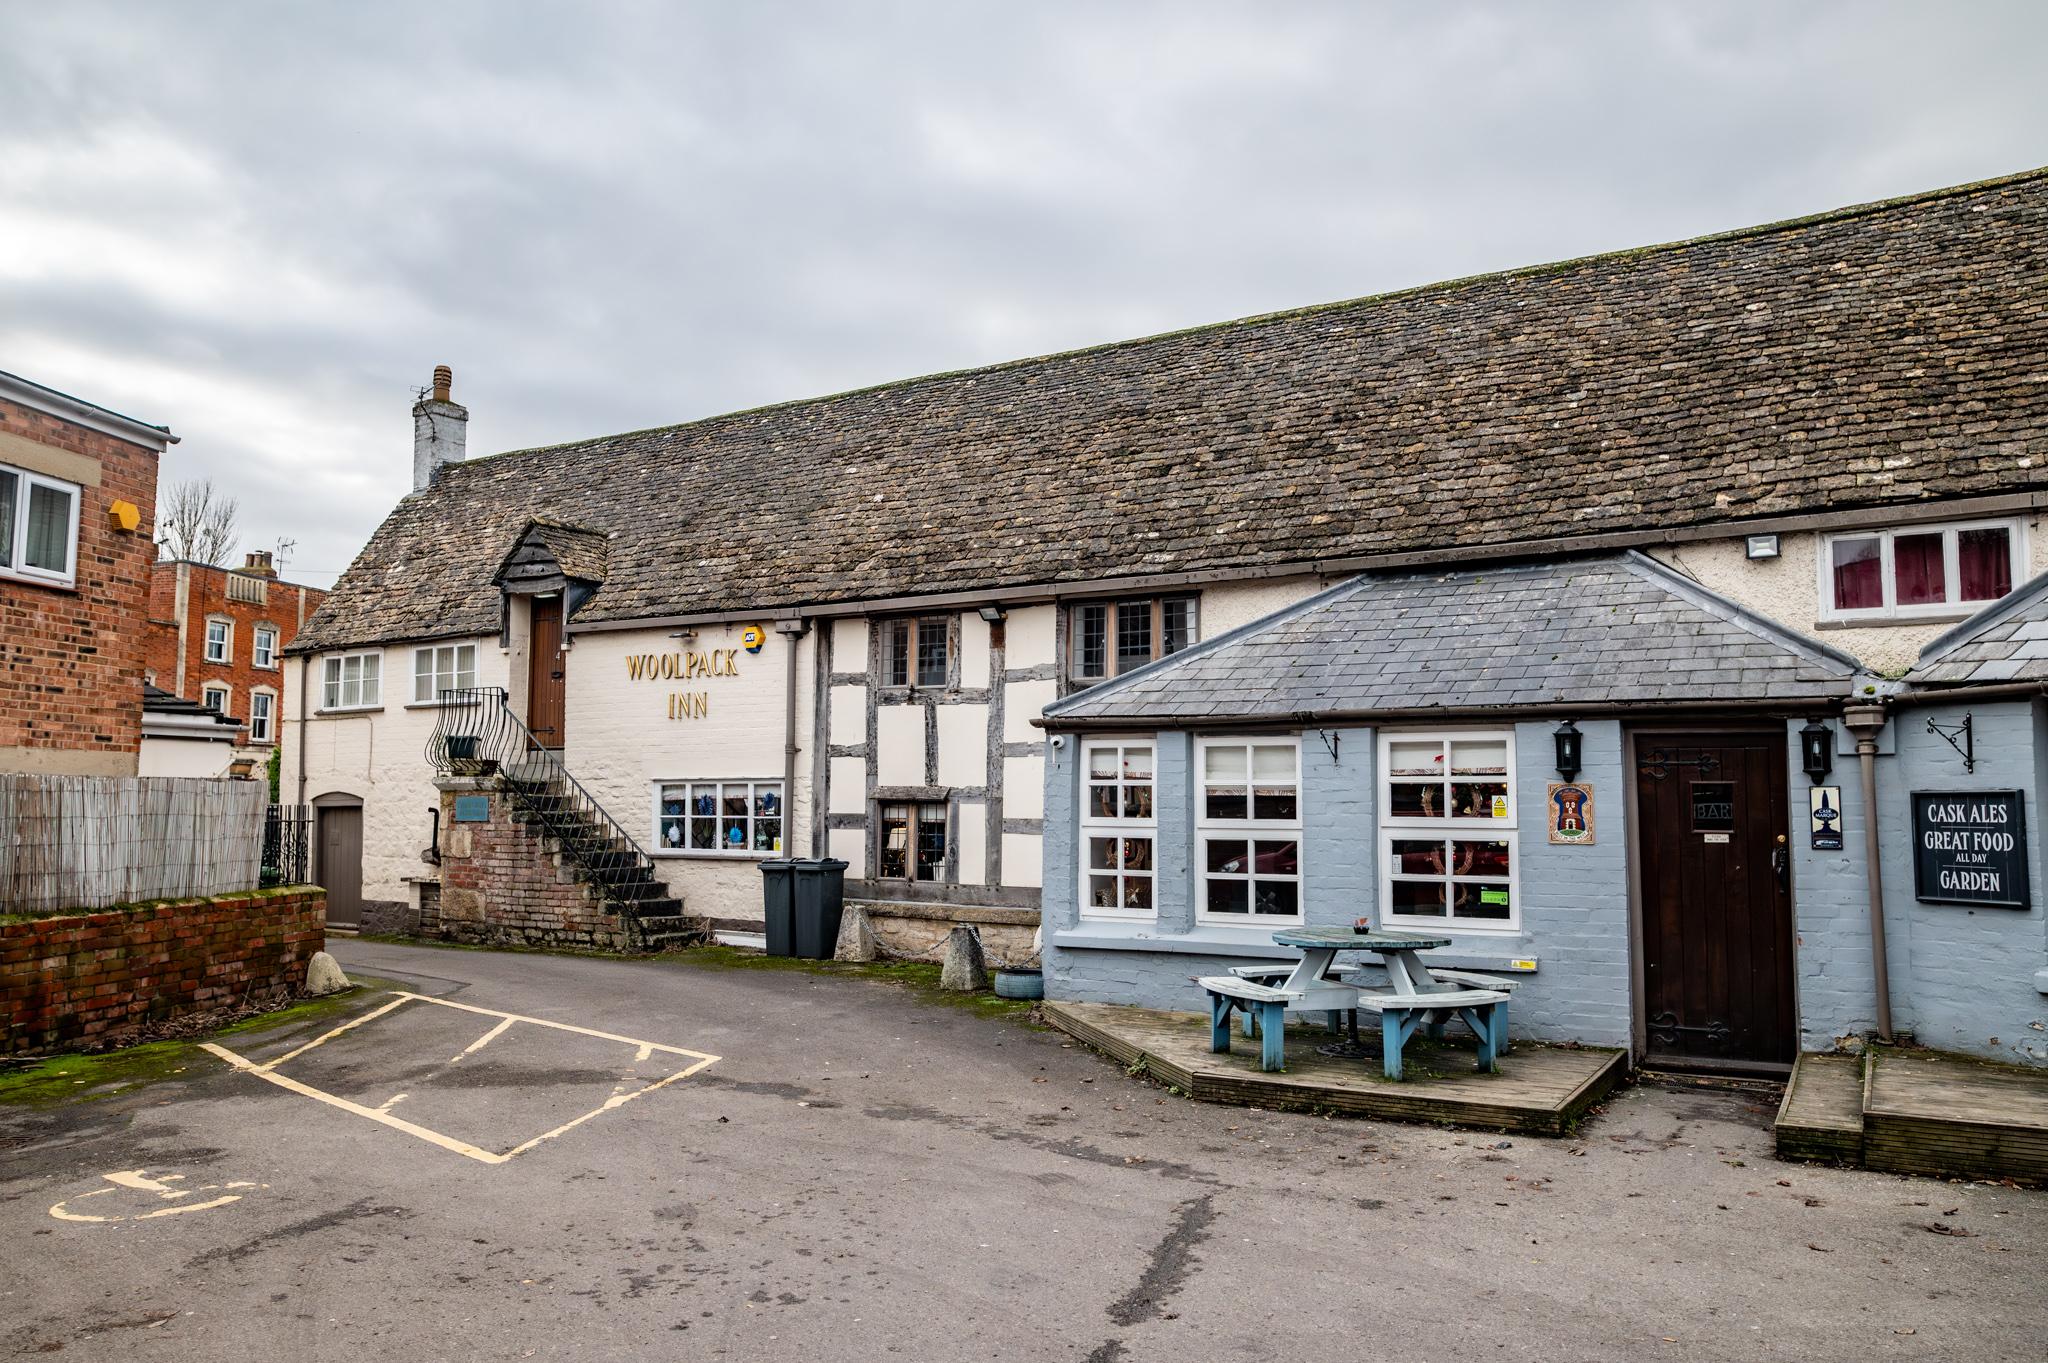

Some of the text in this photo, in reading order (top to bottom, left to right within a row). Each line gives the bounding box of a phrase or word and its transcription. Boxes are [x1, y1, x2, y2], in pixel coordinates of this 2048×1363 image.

[625, 649, 739, 680] WOOLPACK
[668, 691, 708, 720] INN
[1697, 804, 1729, 818] BAR
[1927, 804, 2008, 823] CASK ALES
[1924, 831, 2014, 852] GREAT FOOD
[1955, 853, 1987, 863] ALL DAY
[1940, 870, 2000, 892] GARDEN
